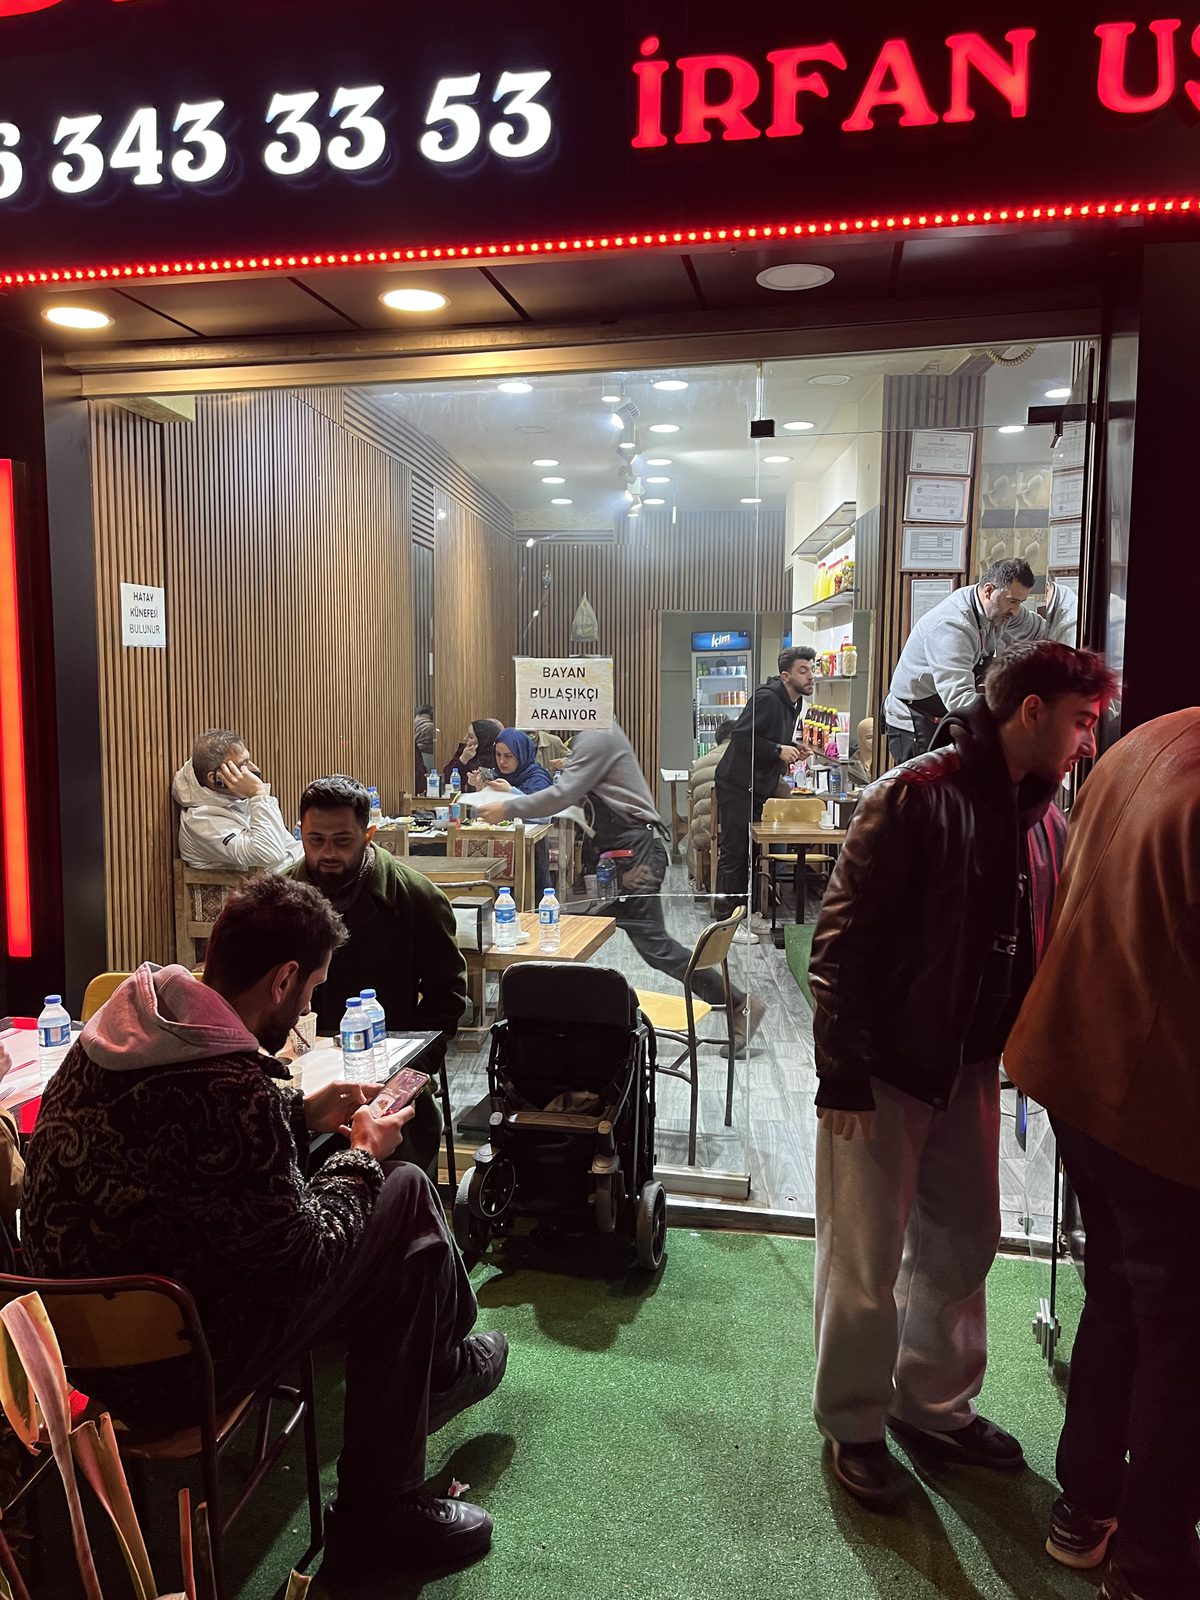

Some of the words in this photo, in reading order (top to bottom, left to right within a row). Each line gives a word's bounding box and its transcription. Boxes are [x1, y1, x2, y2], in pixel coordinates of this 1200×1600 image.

[631, 28, 1036, 148] İRFAN
[51, 100, 227, 194] 343
[263, 85, 387, 176] 33
[419, 70, 552, 164] 53
[133, 592, 154, 602] HATAY
[130, 606, 159, 618] KÜNEFESİ
[129, 624, 161, 635] BULUNUR
[543, 666, 586, 678] BAYAN
[530, 687, 599, 702] BULAŞIKÇI
[530, 708, 597, 720] ARANIYOR
